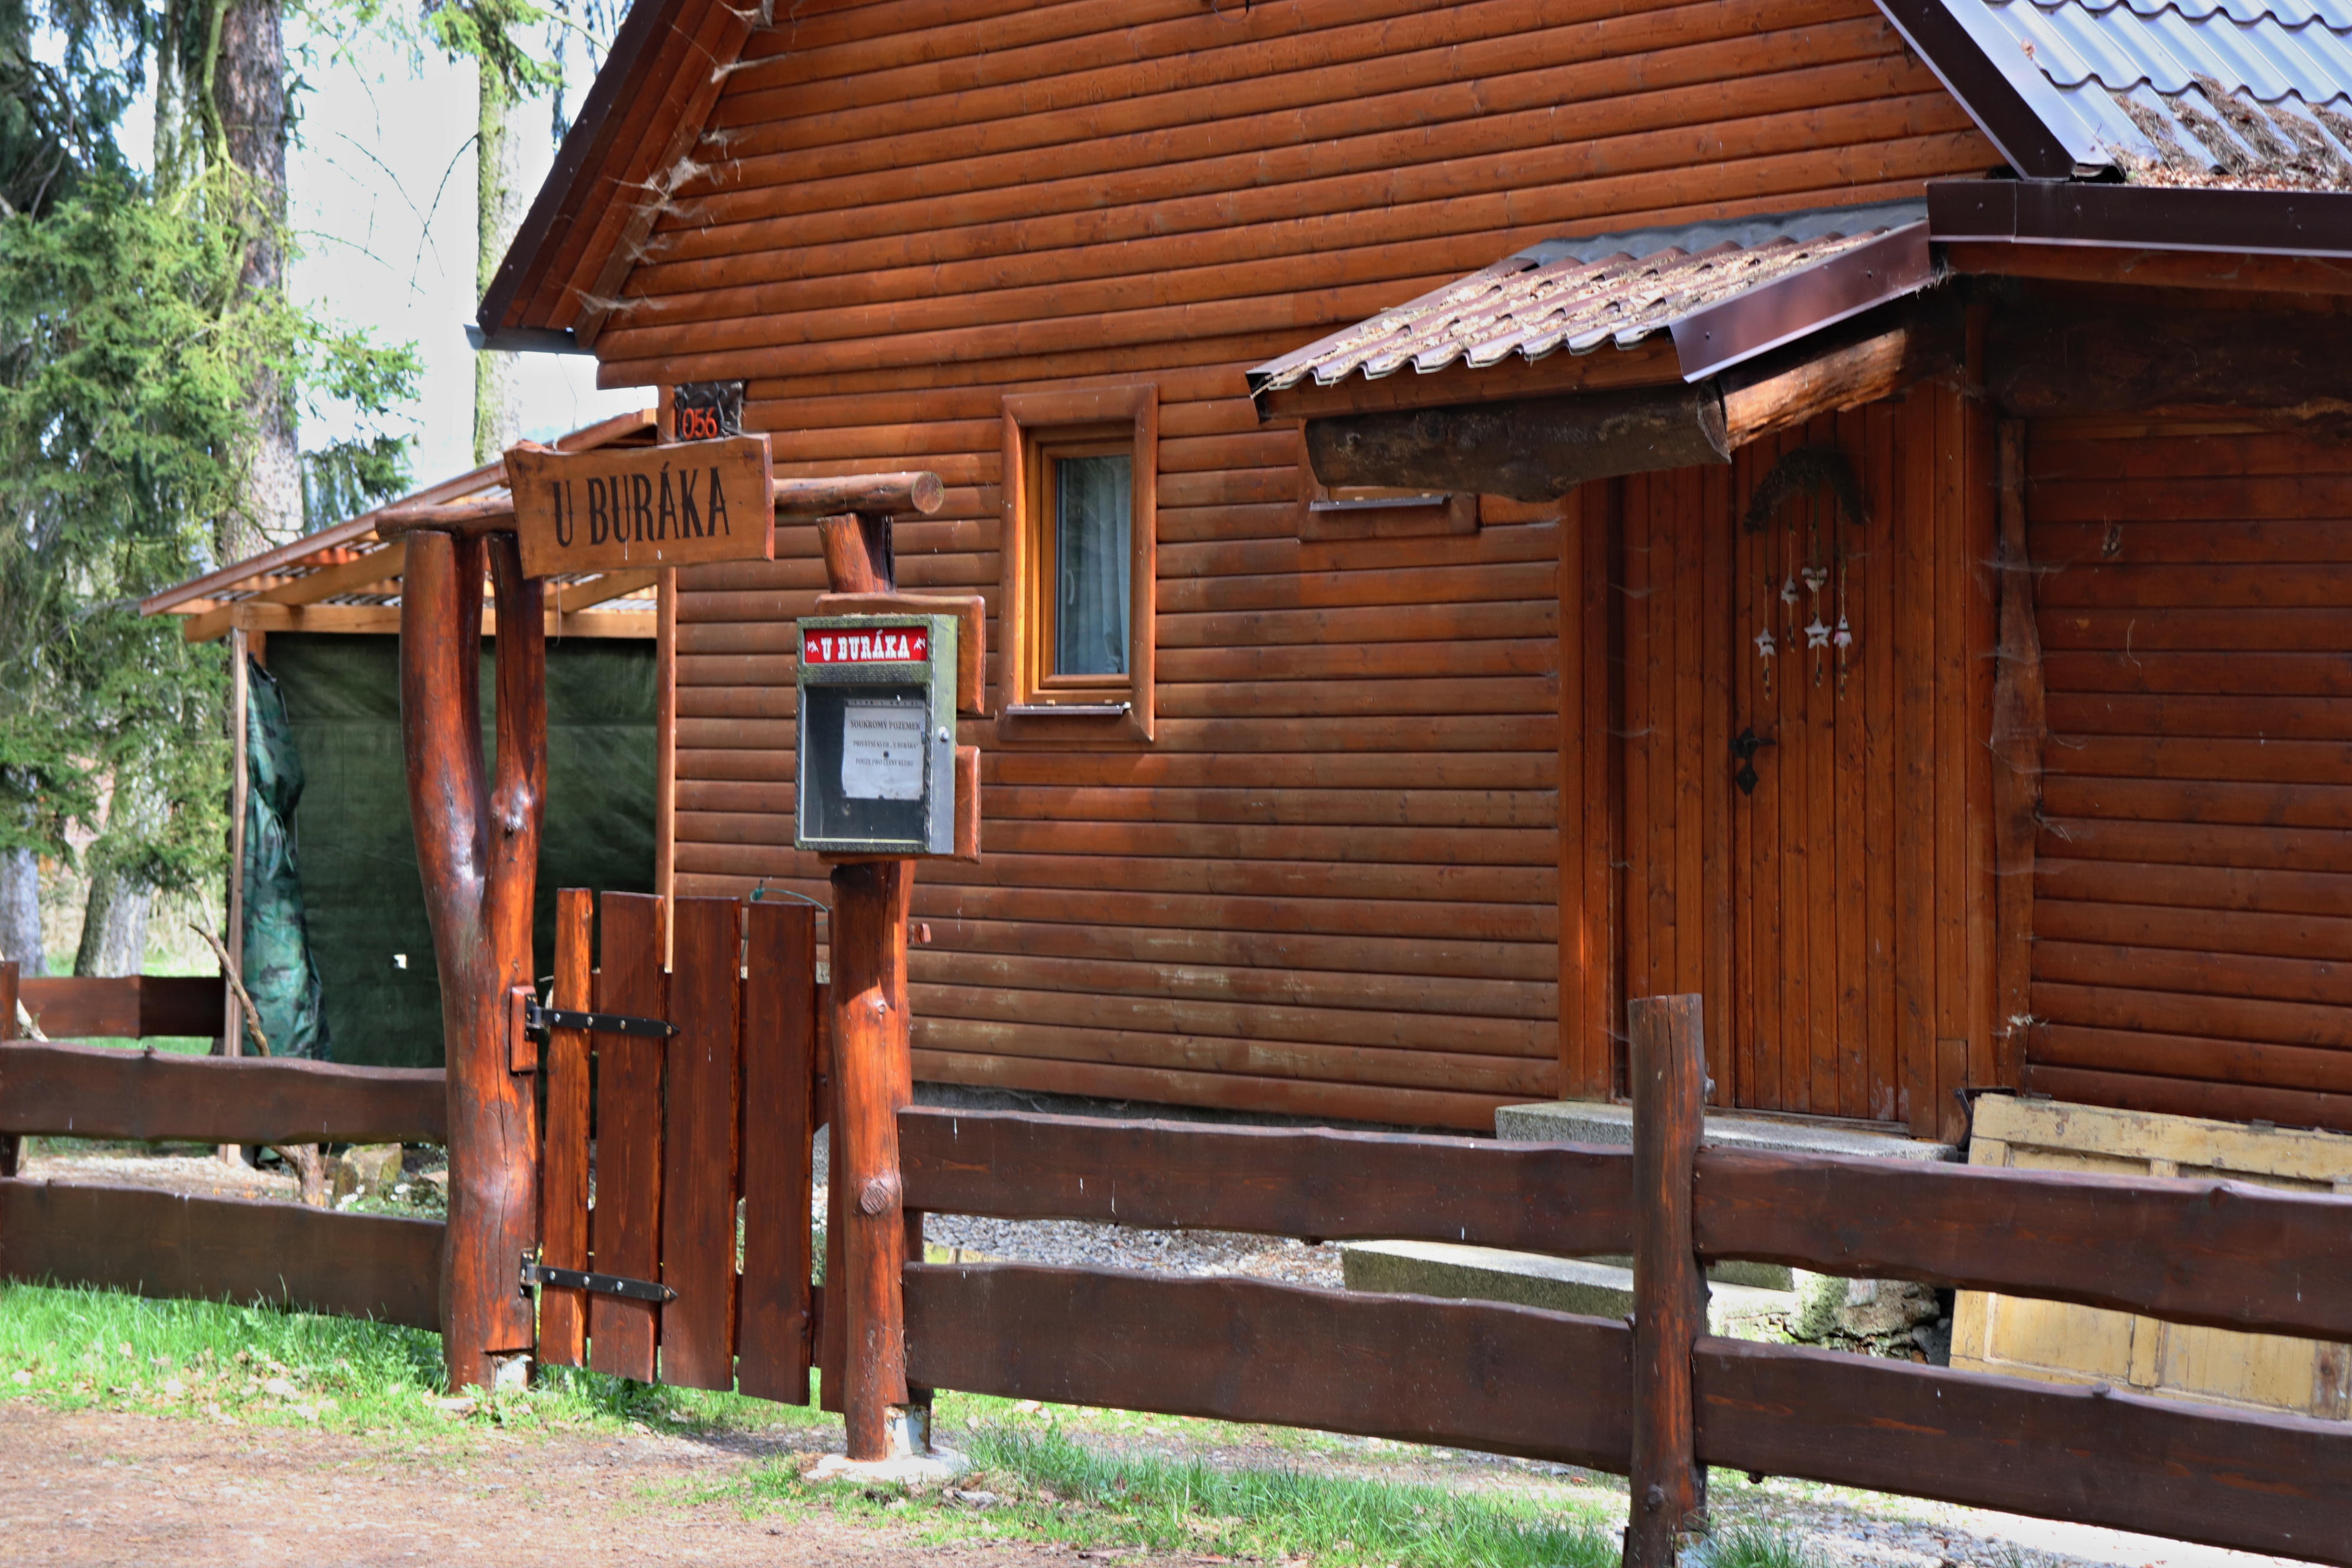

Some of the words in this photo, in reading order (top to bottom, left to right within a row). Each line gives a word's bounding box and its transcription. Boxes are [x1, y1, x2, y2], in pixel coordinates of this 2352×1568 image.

[682, 407, 717, 440] 056
[553, 479, 573, 547] U
[587, 461, 730, 545] BURÁKA
[821, 637, 832, 661] U
[838, 629, 910, 661] BURÁKA
[850, 719, 887, 729] SOUKROMÝ
[889, 721, 920, 731] POZEMEK
[853, 739, 876, 747] PRIVÁTNÍ
